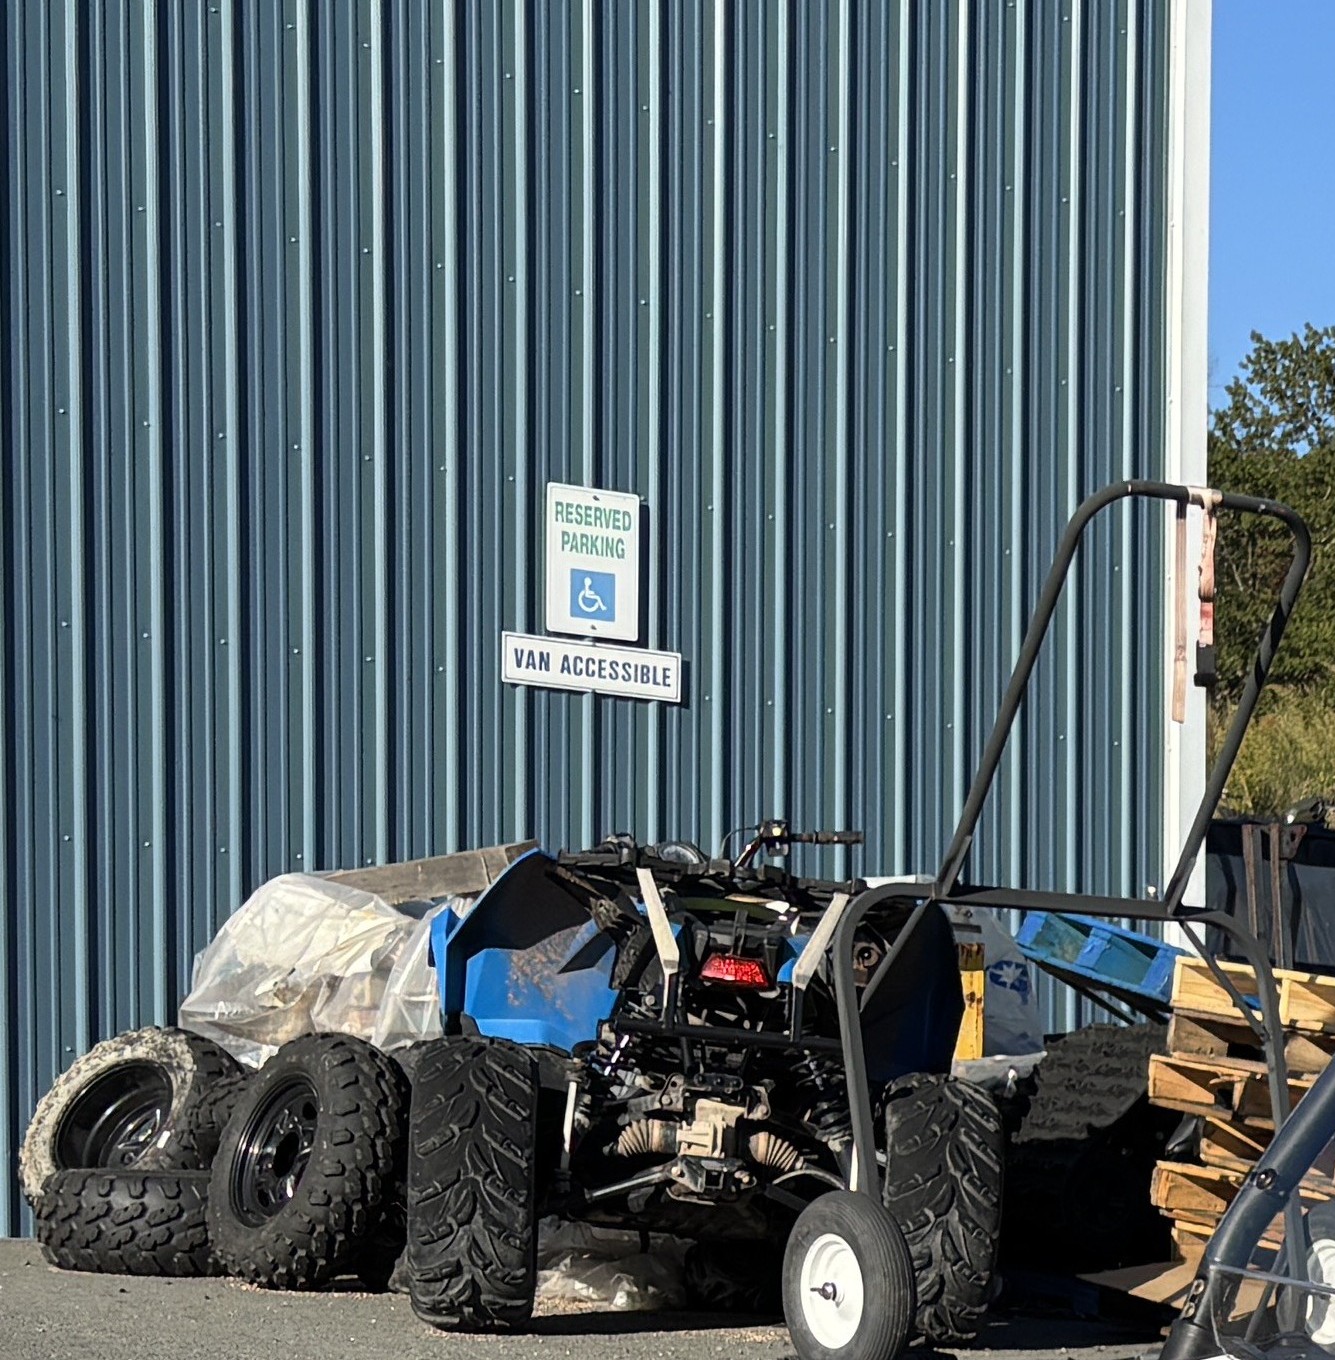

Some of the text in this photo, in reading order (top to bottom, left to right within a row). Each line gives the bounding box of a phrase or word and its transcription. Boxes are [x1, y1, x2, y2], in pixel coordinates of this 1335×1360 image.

[555, 501, 632, 532] RESERVED
[561, 531, 625, 559] PARKING
[514, 648, 671, 688] VAN ACCESSIBLE
